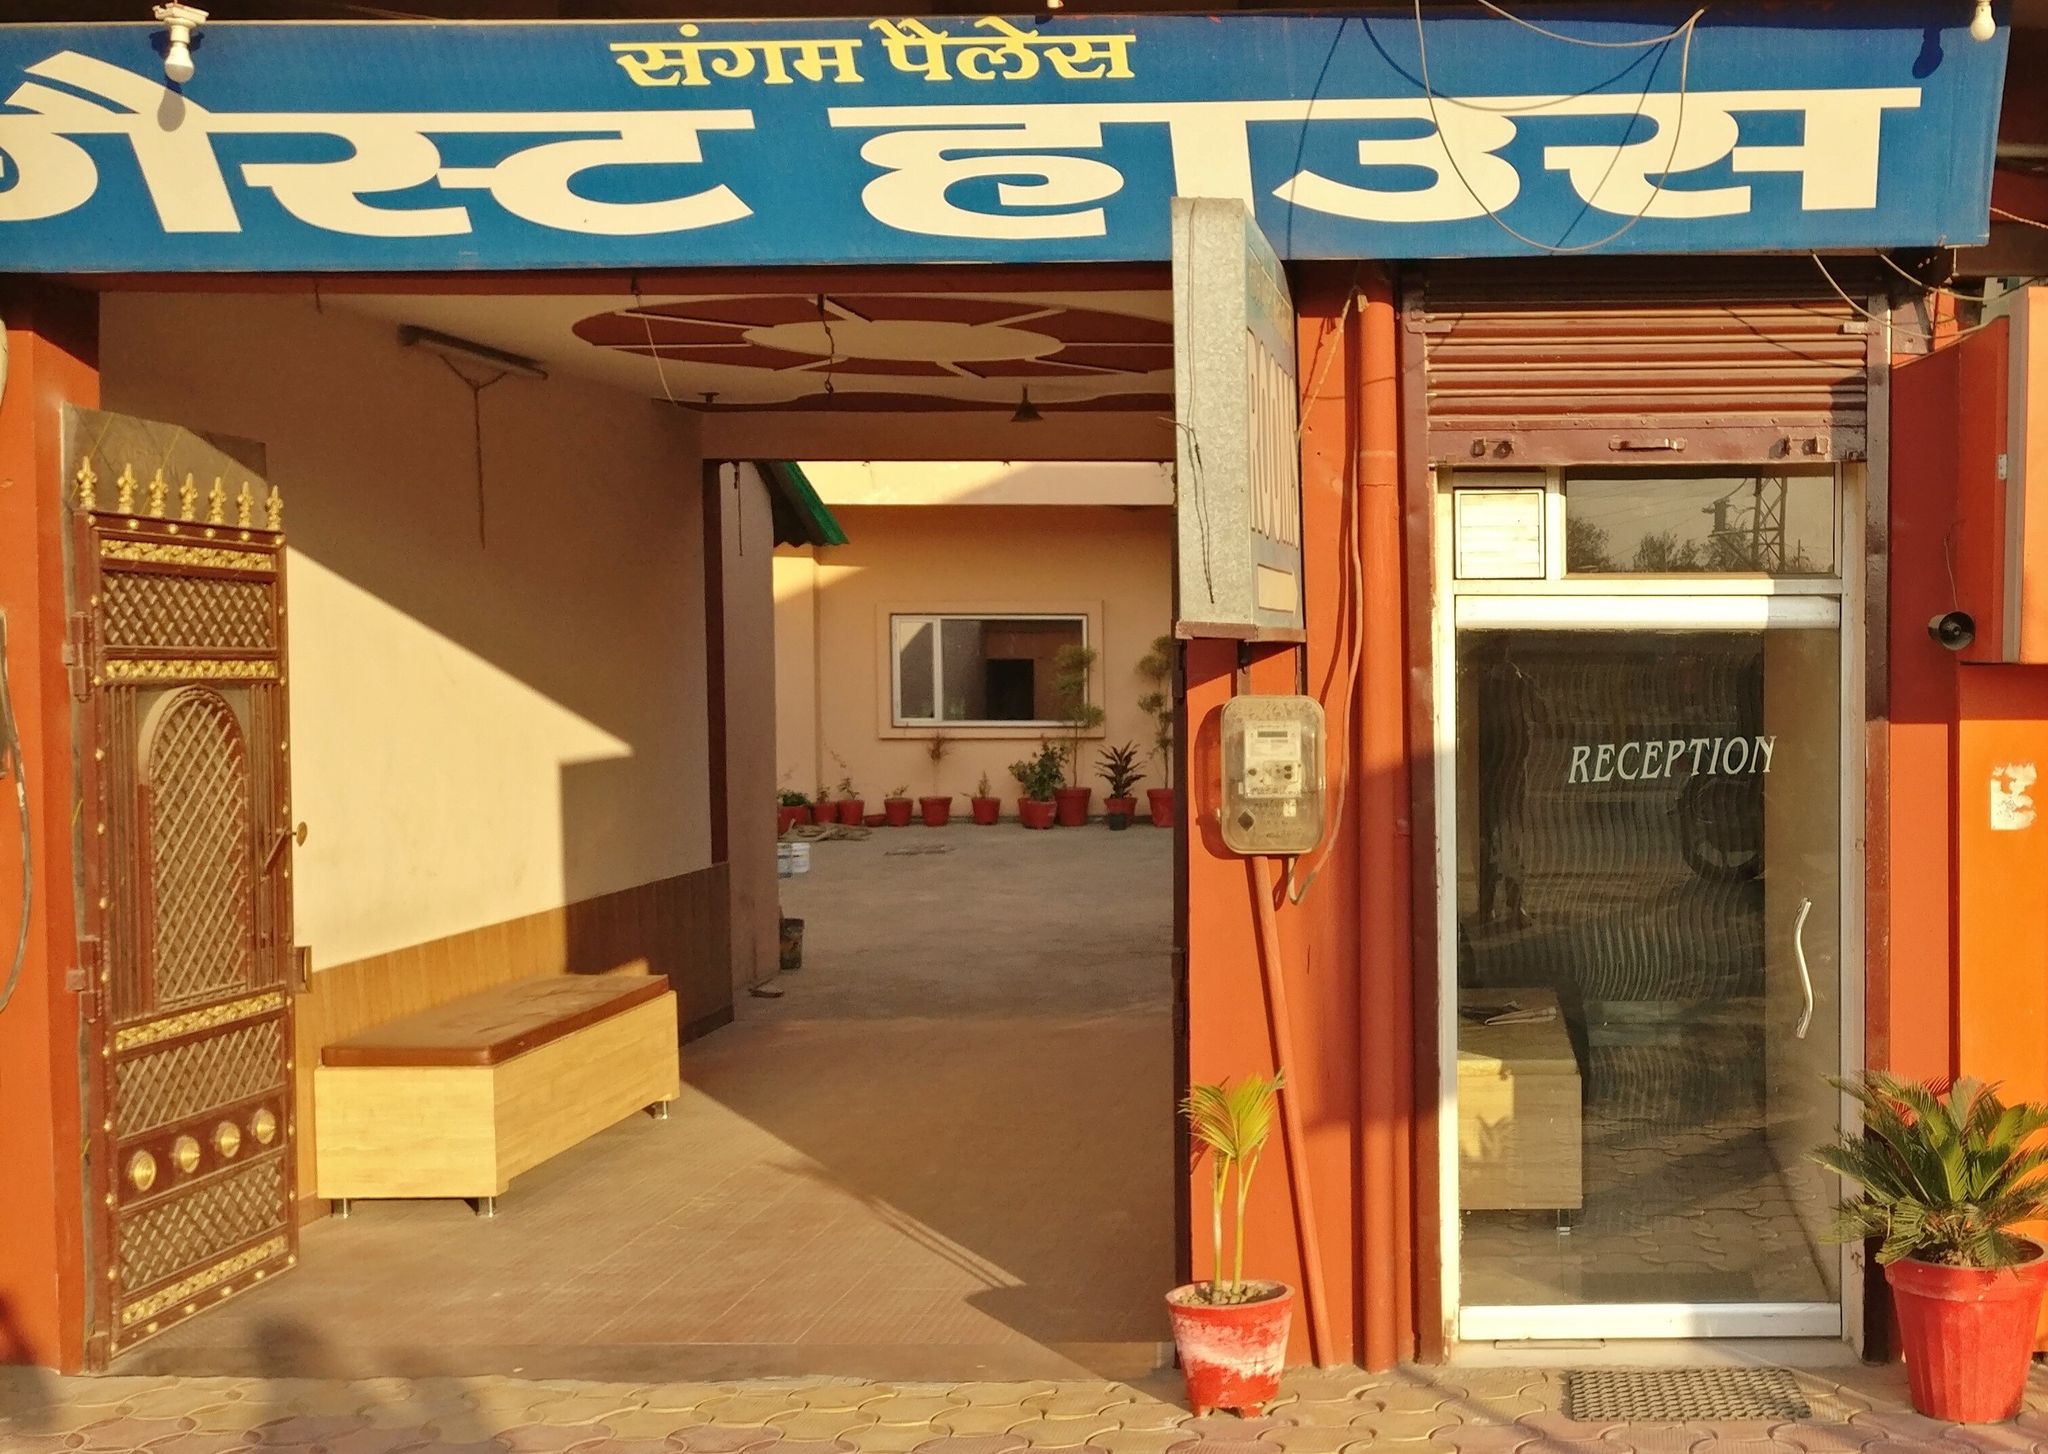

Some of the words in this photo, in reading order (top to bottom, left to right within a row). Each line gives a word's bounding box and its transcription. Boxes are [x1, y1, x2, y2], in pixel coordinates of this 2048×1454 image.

[609, 24, 865, 87] संगम
[868, 18, 1137, 82] पैलेस
[827, 87, 1923, 240] हाउस
[1246, 326, 1300, 550] ROOMS
[1568, 735, 1777, 784] RECEPTION
